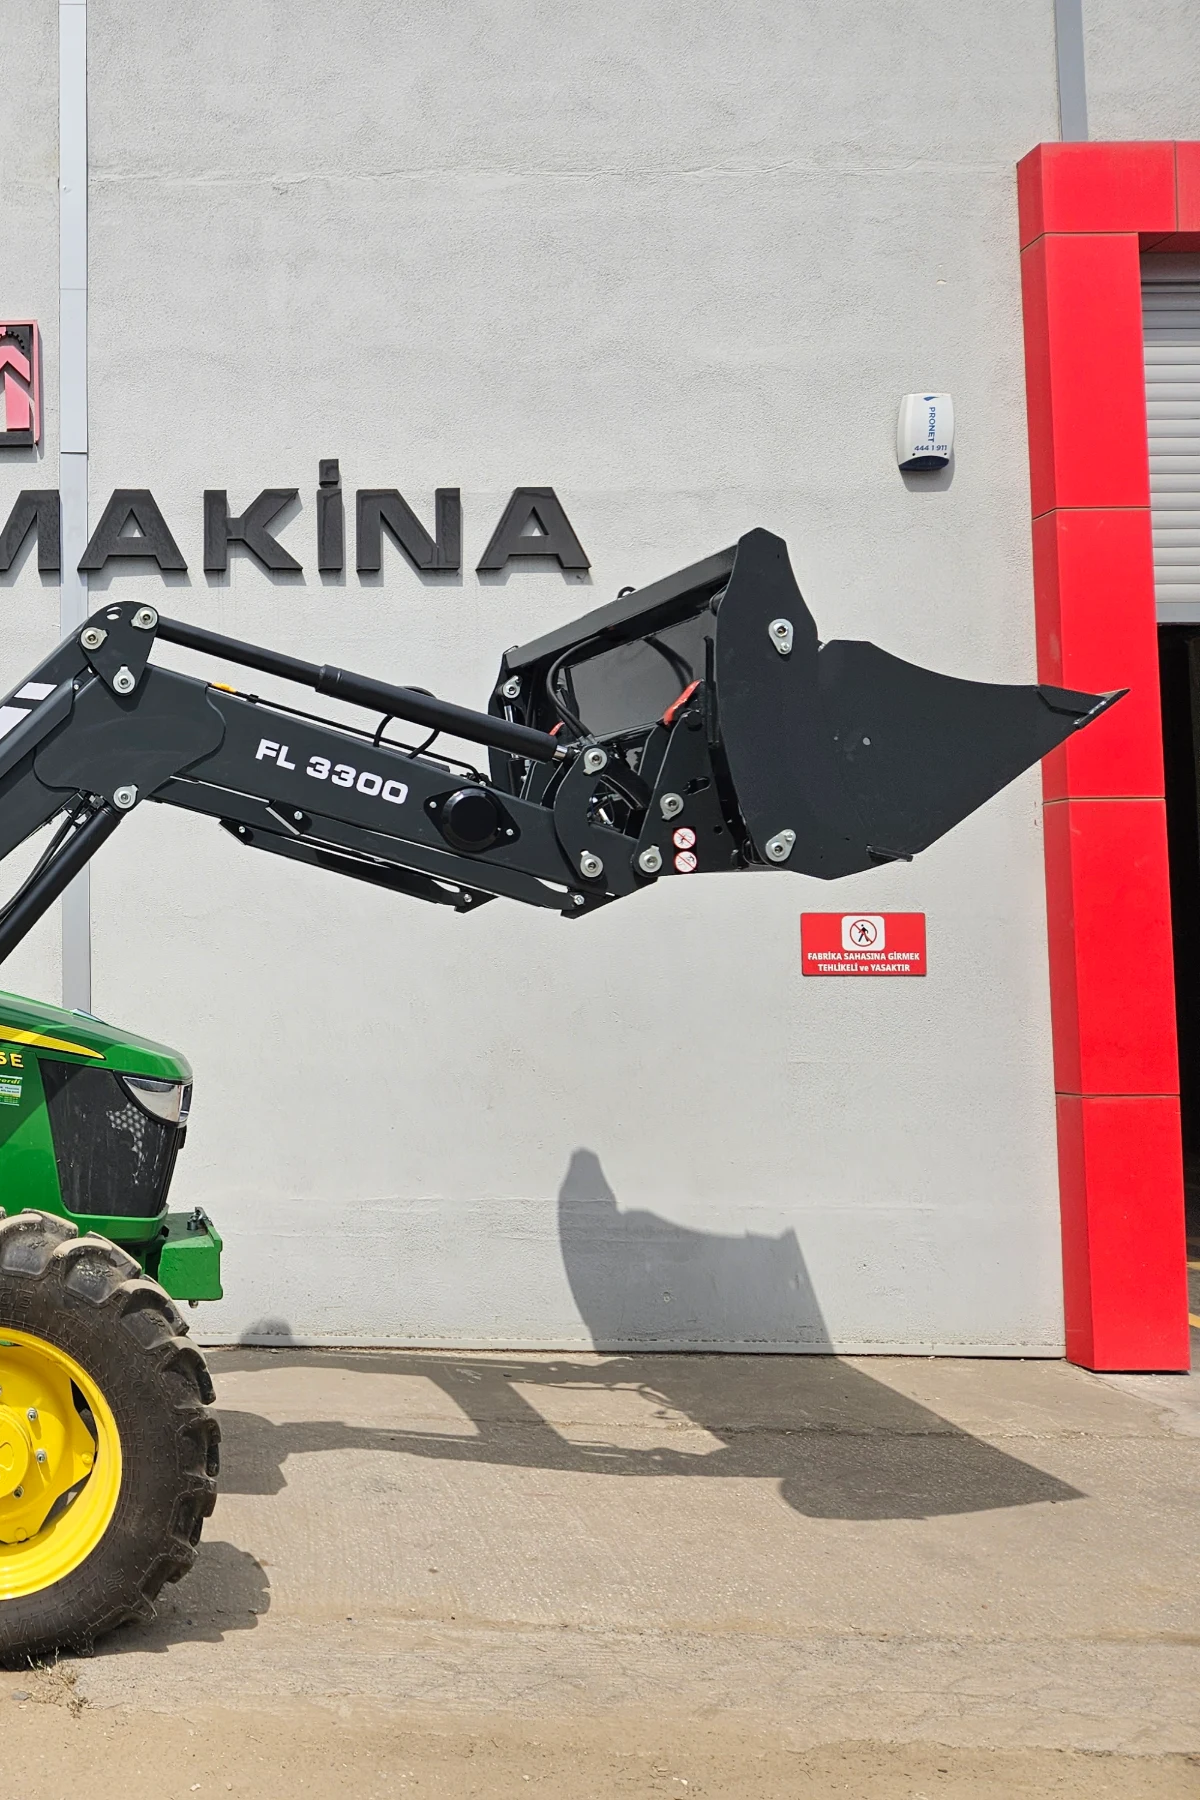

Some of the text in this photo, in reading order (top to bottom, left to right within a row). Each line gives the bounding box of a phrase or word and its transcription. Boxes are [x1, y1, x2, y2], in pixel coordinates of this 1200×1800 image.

[928, 406, 936, 443] PRONET
[255, 738, 409, 805] FL 3300
[807, 951, 920, 961] FABRİKA SAHASINA GİRMEK
[818, 962, 858, 972] TEHLİKELİ
[871, 963, 910, 972] YASAKTIR
[9, 1052, 25, 1069] E
